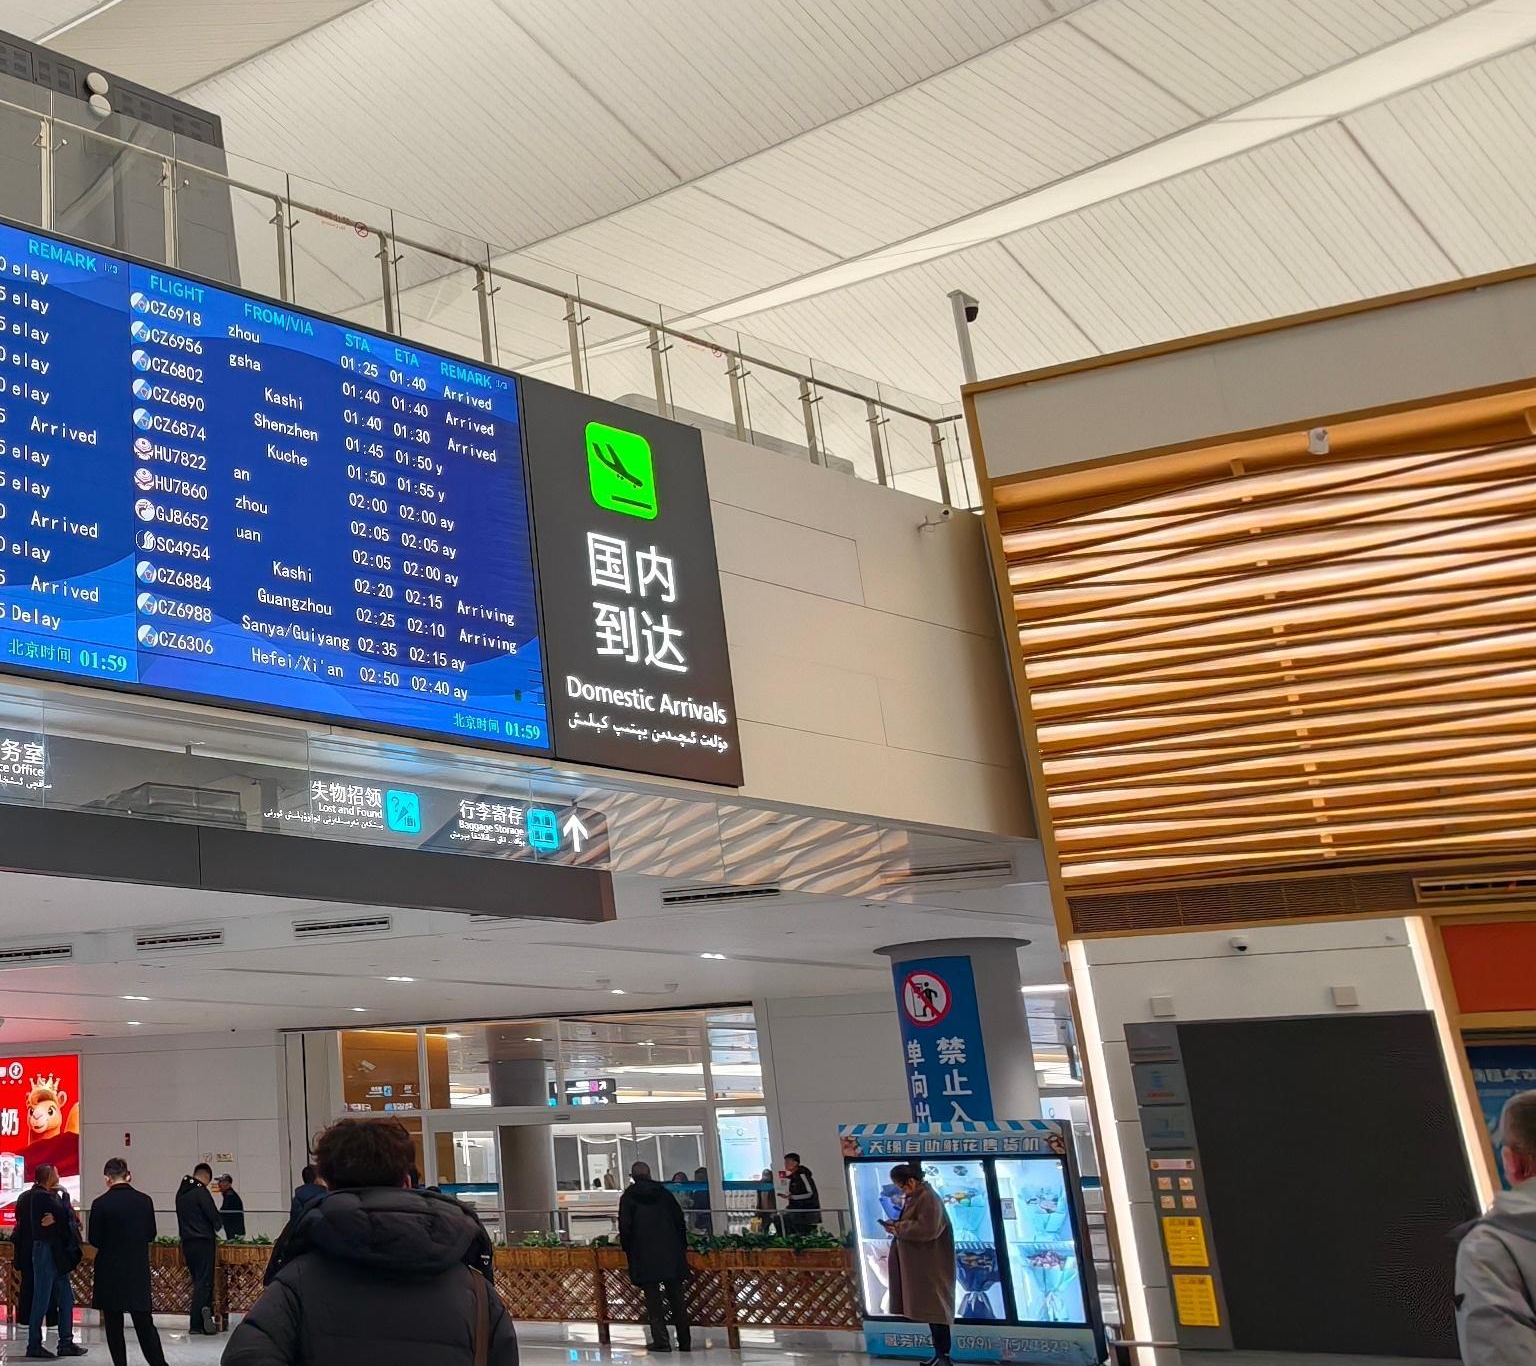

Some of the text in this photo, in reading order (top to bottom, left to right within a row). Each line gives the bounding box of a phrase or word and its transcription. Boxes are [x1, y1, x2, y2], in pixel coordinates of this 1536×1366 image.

[28, 238, 97, 272] REMARK
[149, 273, 205, 304] FLIGHT
[243, 302, 314, 337] FROM/VIA
[344, 332, 371, 353] STA
[394, 347, 420, 368] ETA
[439, 361, 492, 389] REMARK
[149, 299, 202, 327] CZ6918
[339, 354, 379, 378] 01:25
[388, 368, 427, 392] 01:40
[442, 384, 492, 411] Arrived
[150, 327, 495, 437] CZ6956 01:40 01:40 Arrived
[151, 356, 497, 463] CZ6802 Kashi 01:40 01:30 Arrived
[29, 415, 97, 445] Arrived
[152, 385, 205, 412] CZ6890
[253, 411, 318, 442] Shenzhen
[344, 435, 384, 459] 01:45
[394, 448, 433, 471] 01:50
[152, 414, 207, 442] CZ6874
[266, 442, 308, 467] Kuche
[346, 463, 386, 486] 01:50
[396, 476, 435, 499] 01:55
[153, 443, 207, 471] HU7822
[348, 491, 388, 514] 02:00
[398, 503, 437, 526] 02:00
[154, 473, 208, 501] HU7860
[349, 519, 390, 542] 02:05
[400, 531, 439, 554] 02:05
[30, 509, 98, 539] Arrived
[154, 504, 209, 531] GJ8652
[351, 548, 392, 571] 02:05
[402, 559, 441, 582] 02:00
[30, 574, 99, 603] Arrived
[155, 535, 515, 627] SC4954 Kashi 02:20 02:15 Arriving
[586, 531, 676, 603] 国内
[11, 603, 61, 631] Delay
[156, 566, 517, 655] CZ6884 Guangzhou 02:25 02:10 Arriving
[157, 598, 212, 623] CZ6988
[241, 613, 350, 652] Sanya/Guiyang
[356, 636, 398, 658] 02:35
[408, 645, 448, 667] 02:15
[592, 601, 689, 673] 到达
[7, 637, 128, 673] 北京时间 01:59
[158, 630, 214, 655] CZ6306
[251, 646, 344, 678] Hefei/Xi'an
[358, 665, 400, 687] 02:50
[410, 675, 450, 696] 02:40
[452, 712, 541, 740] 北京时间 01:59
[566, 675, 728, 725] Domestic Arrivals
[12, 763, 45, 778] Office
[311, 780, 383, 808] 失物招领
[318, 802, 383, 819] Lost and Found
[459, 800, 524, 826] 行李寄存
[459, 820, 525, 836] Baggage Storage
